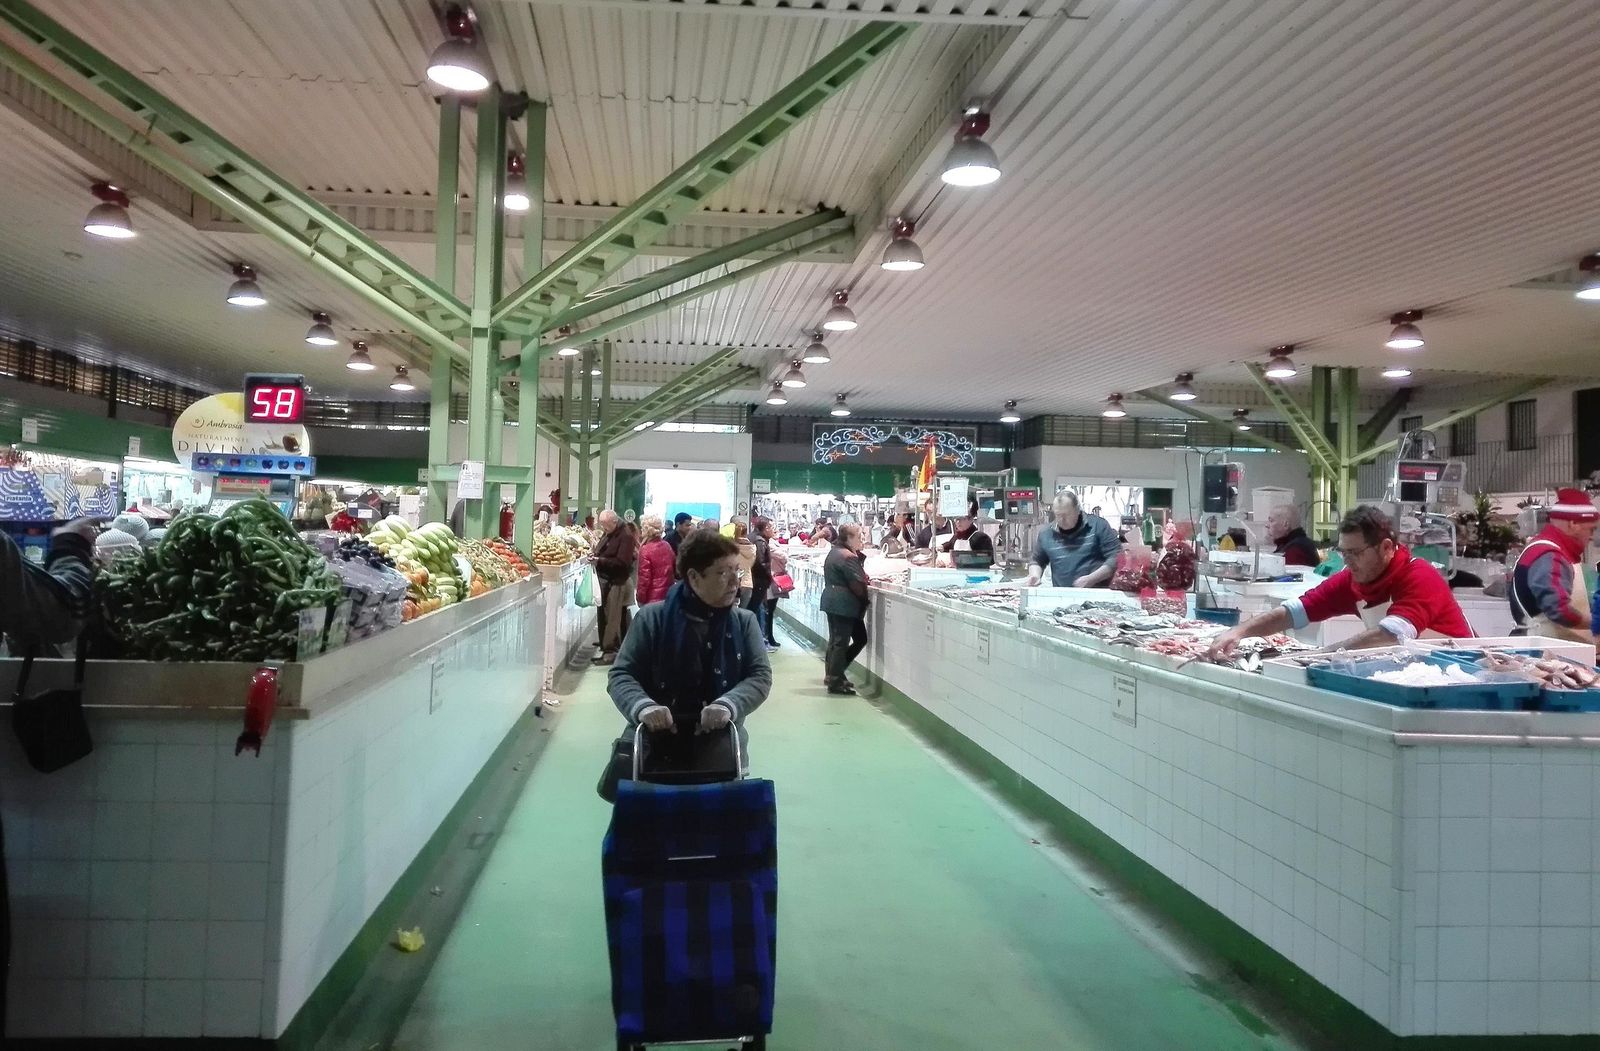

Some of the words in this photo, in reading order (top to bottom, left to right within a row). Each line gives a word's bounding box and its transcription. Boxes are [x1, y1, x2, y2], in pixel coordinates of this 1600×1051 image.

[252, 388, 296, 418] 58
[206, 419, 243, 430] Ambrosia
[178, 440, 257, 455] DIVINA
